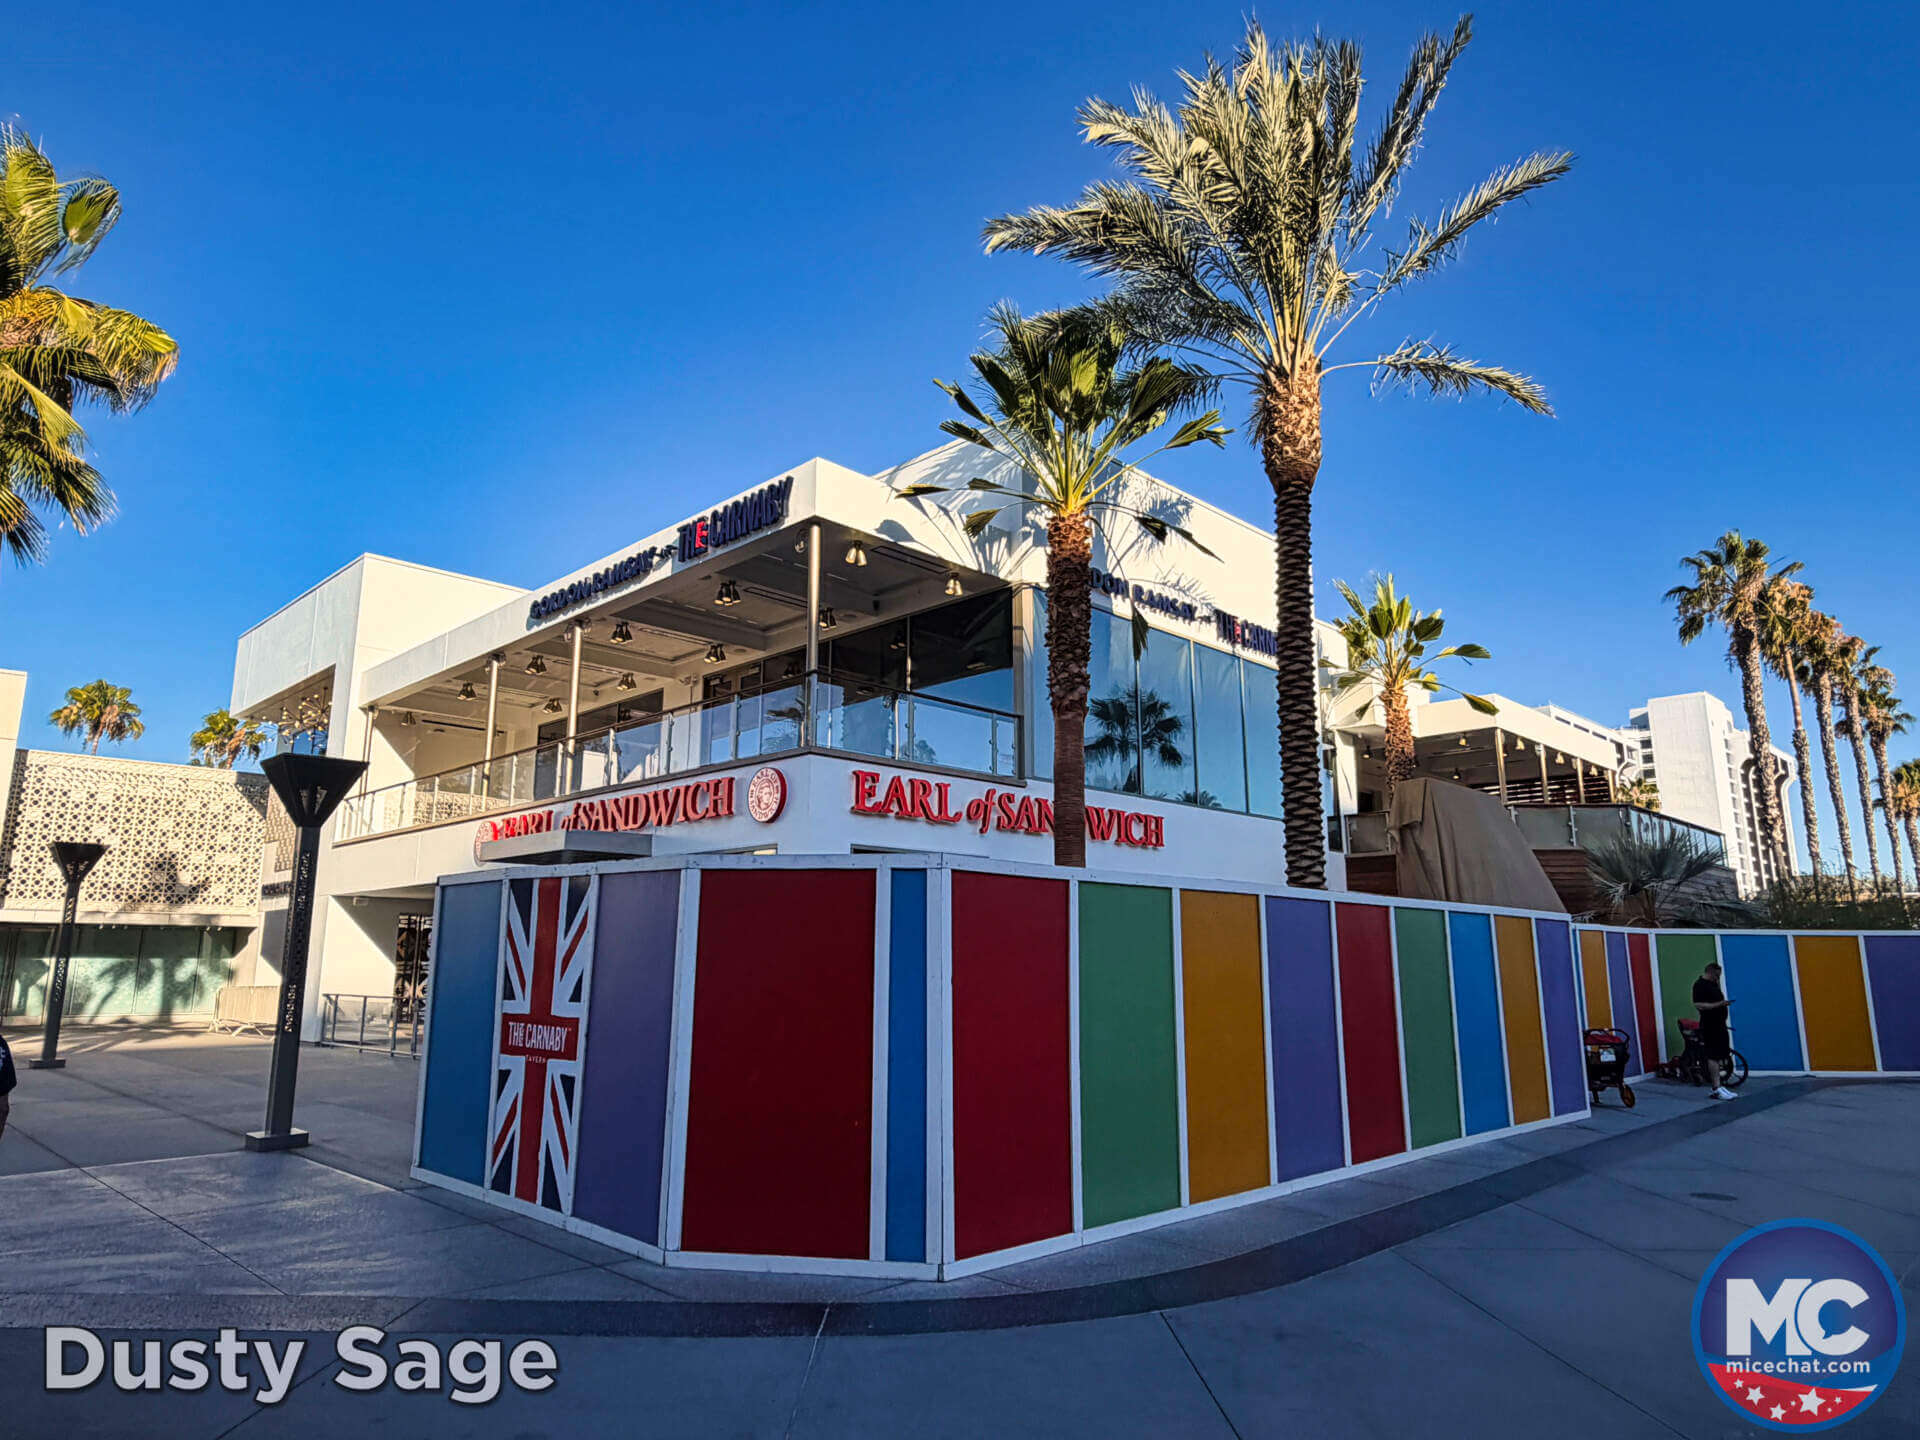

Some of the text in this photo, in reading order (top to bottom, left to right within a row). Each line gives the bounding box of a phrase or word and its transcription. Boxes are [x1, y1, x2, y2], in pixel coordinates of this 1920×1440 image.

[530, 475, 794, 619] GORDON RAMSAY THE CARNABY
[1086, 567, 1130, 599] DON
[1132, 584, 1198, 622] RAMSAY
[577, 777, 735, 832] SANDWICH
[851, 770, 1165, 848] EARL of SANWICH
[508, 1021, 568, 1053] THE CARNABY
